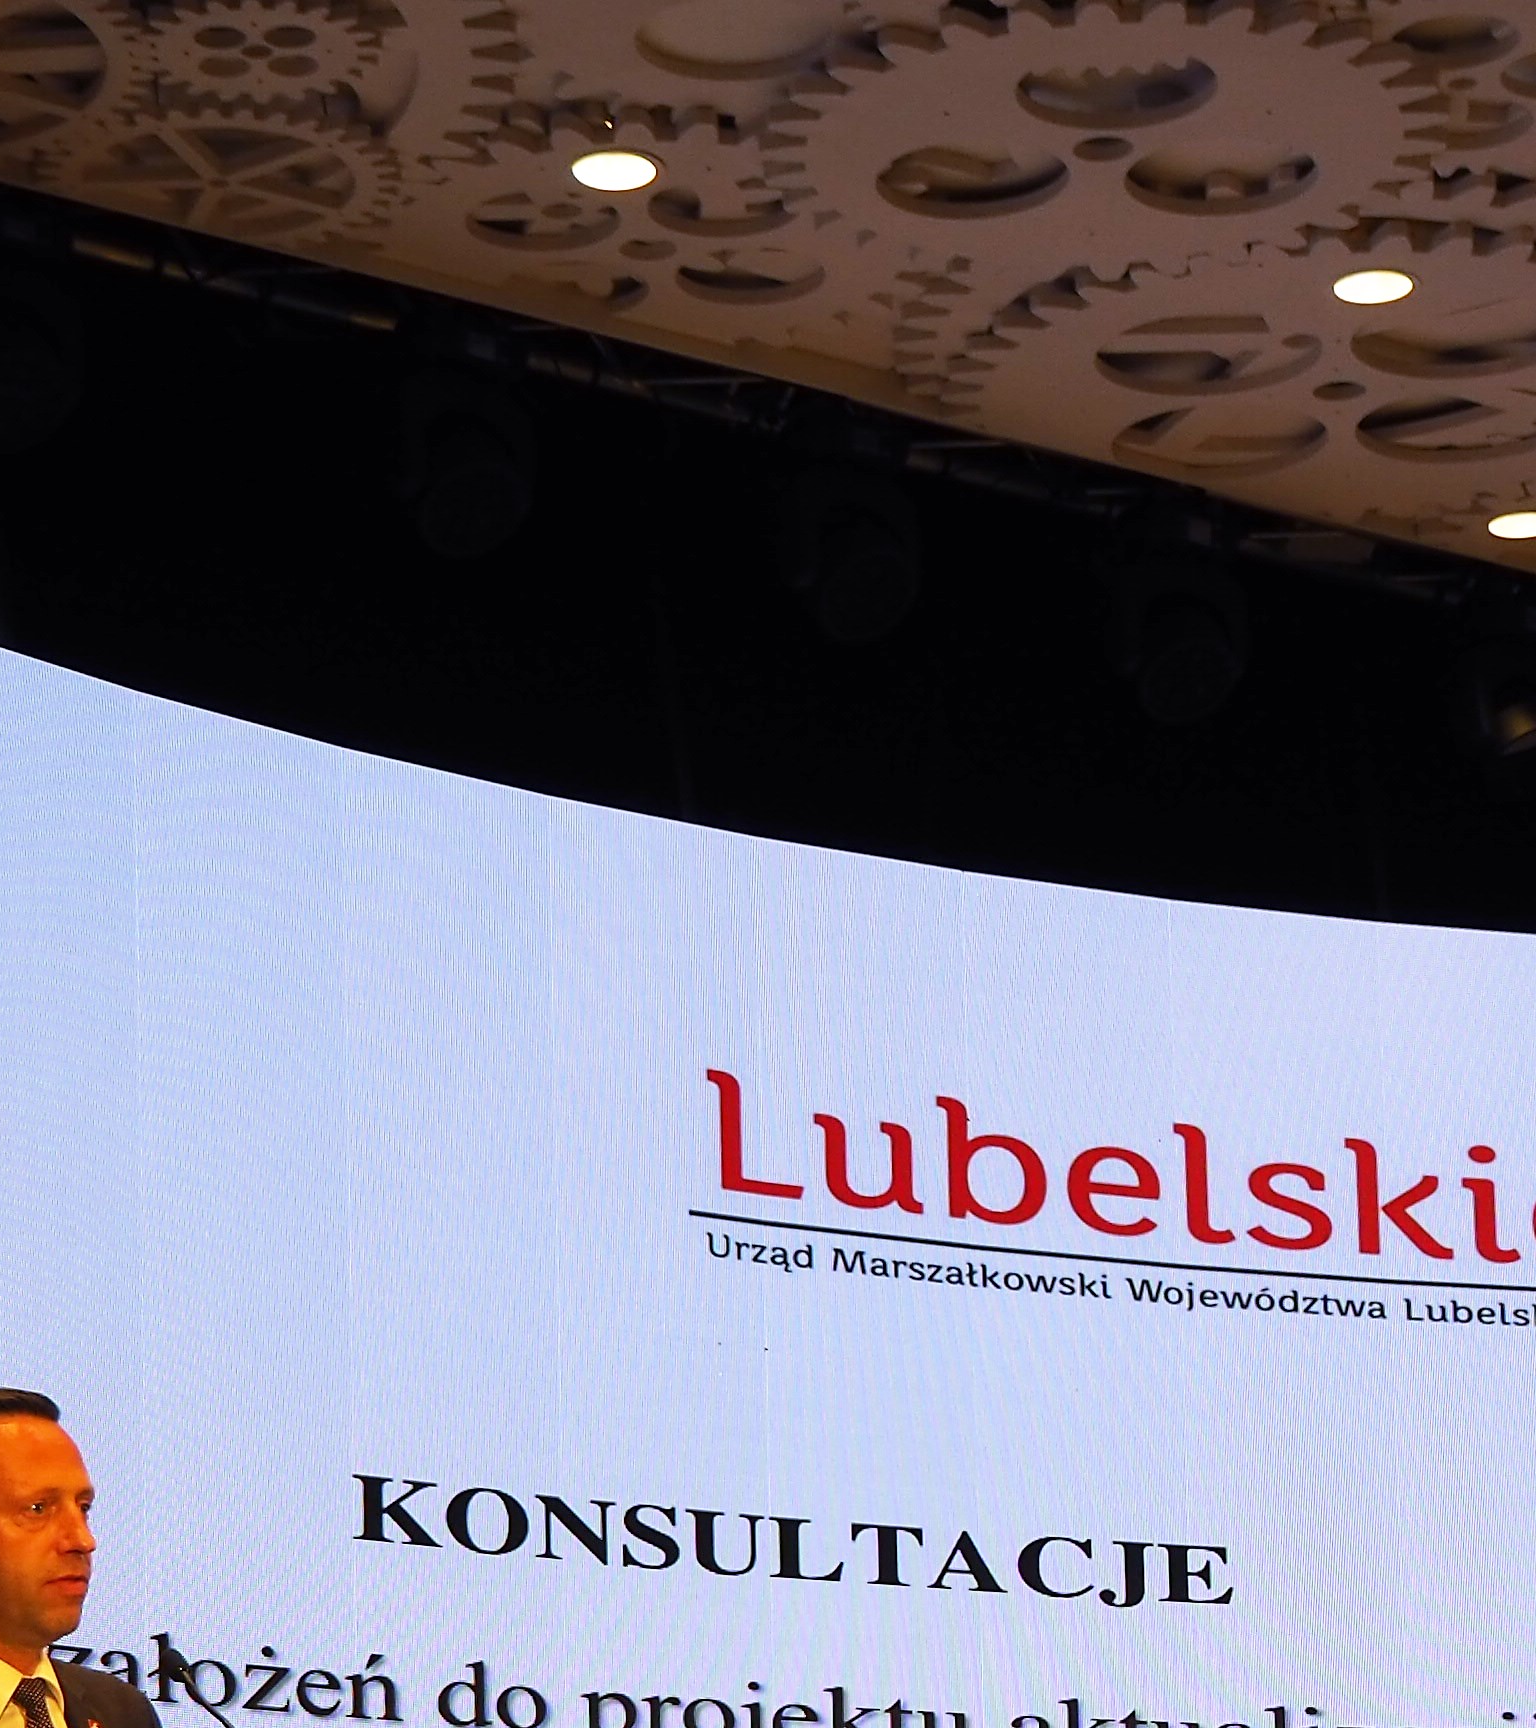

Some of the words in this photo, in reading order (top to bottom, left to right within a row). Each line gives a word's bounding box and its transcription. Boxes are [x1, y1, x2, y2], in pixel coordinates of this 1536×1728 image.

[706, 1231, 814, 1273] Urząd
[831, 1246, 1113, 1299] Marszałkowski
[1125, 1276, 1388, 1319] Województwa
[352, 1474, 1234, 1608] KONSULTACJE
